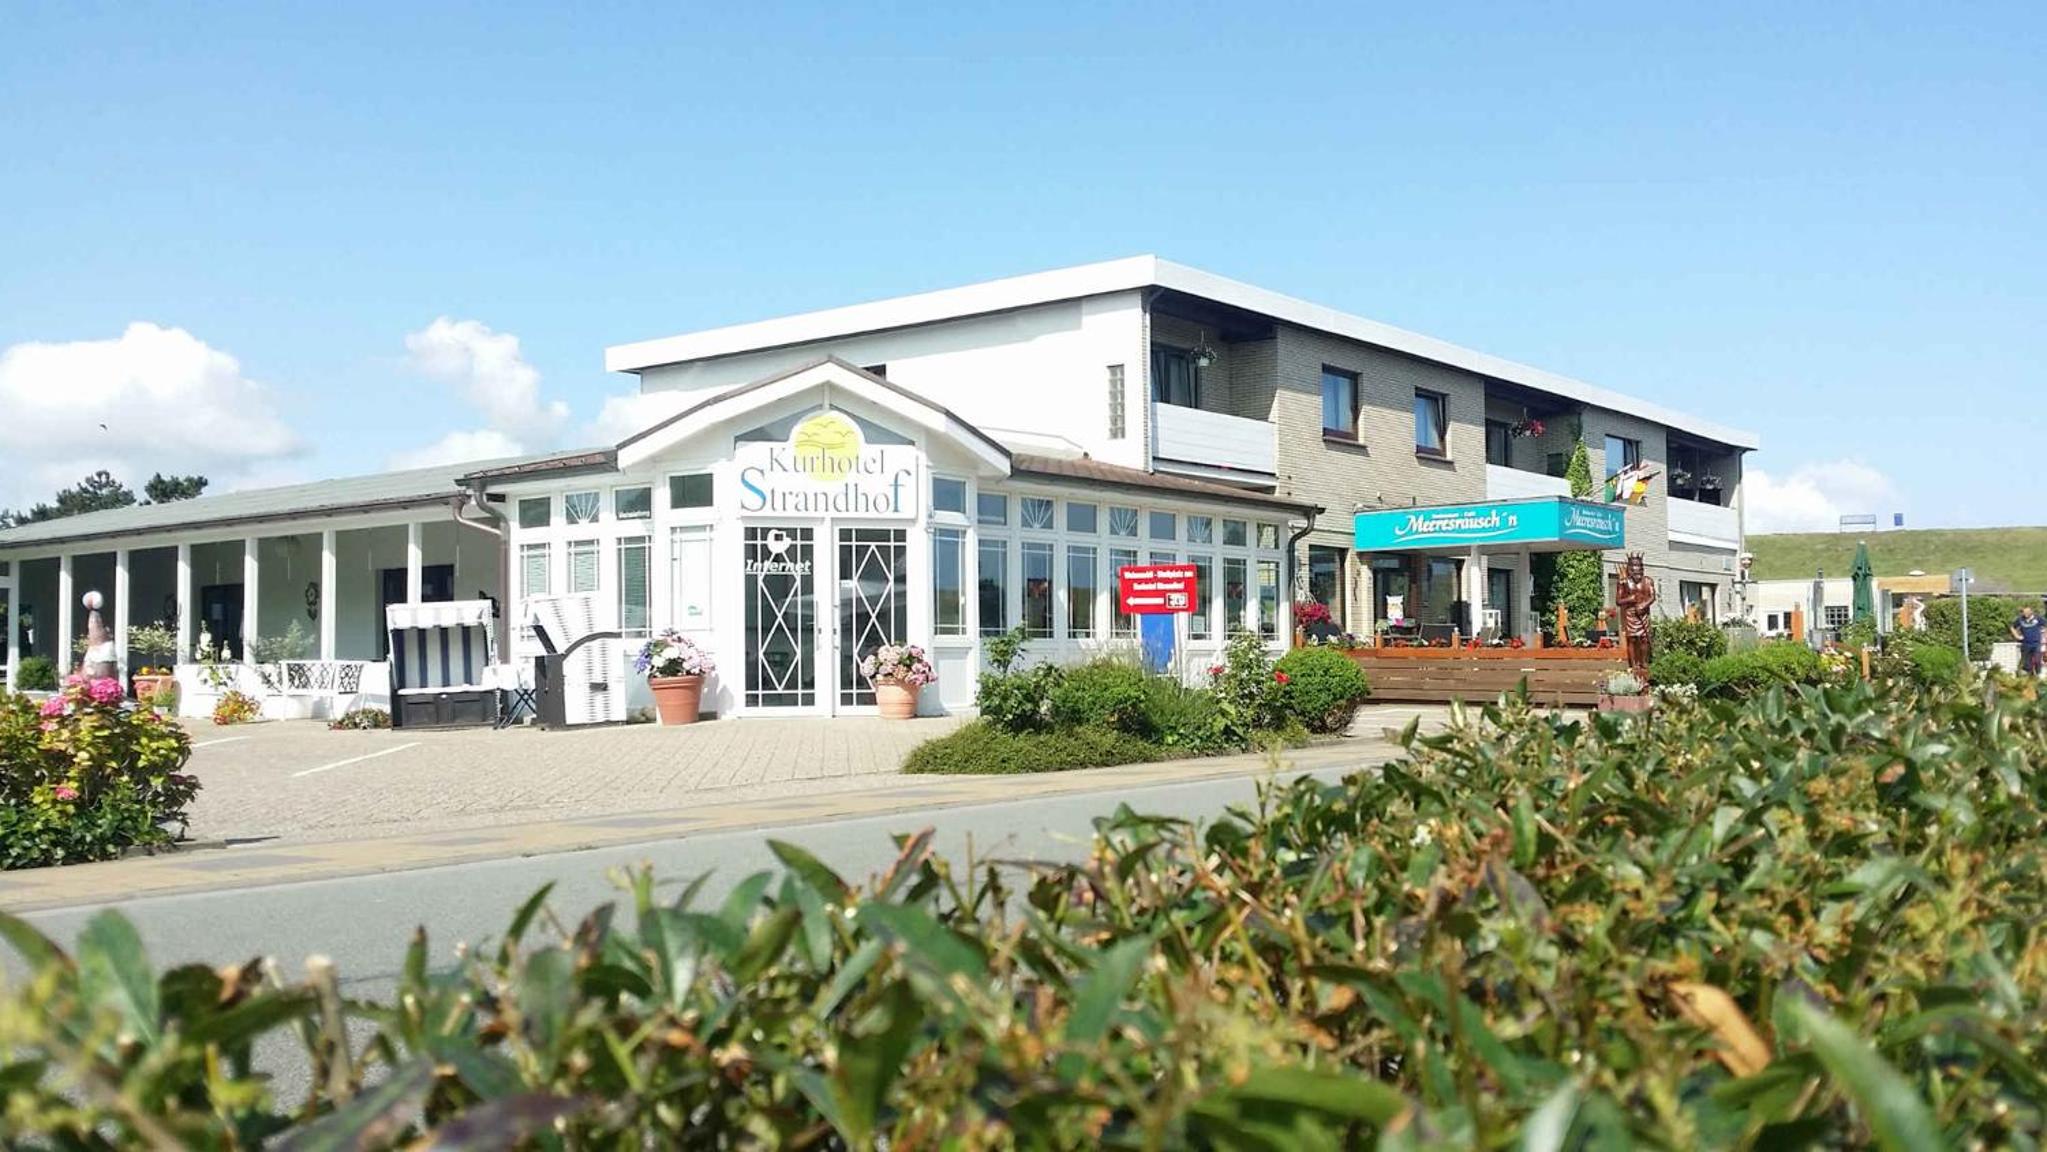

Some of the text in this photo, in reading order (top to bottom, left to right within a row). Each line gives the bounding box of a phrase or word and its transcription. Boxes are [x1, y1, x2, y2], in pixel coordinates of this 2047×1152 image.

[769, 447, 885, 475] Kurhotel
[740, 466, 912, 513] Strandhof
[745, 559, 811, 573] Internet
